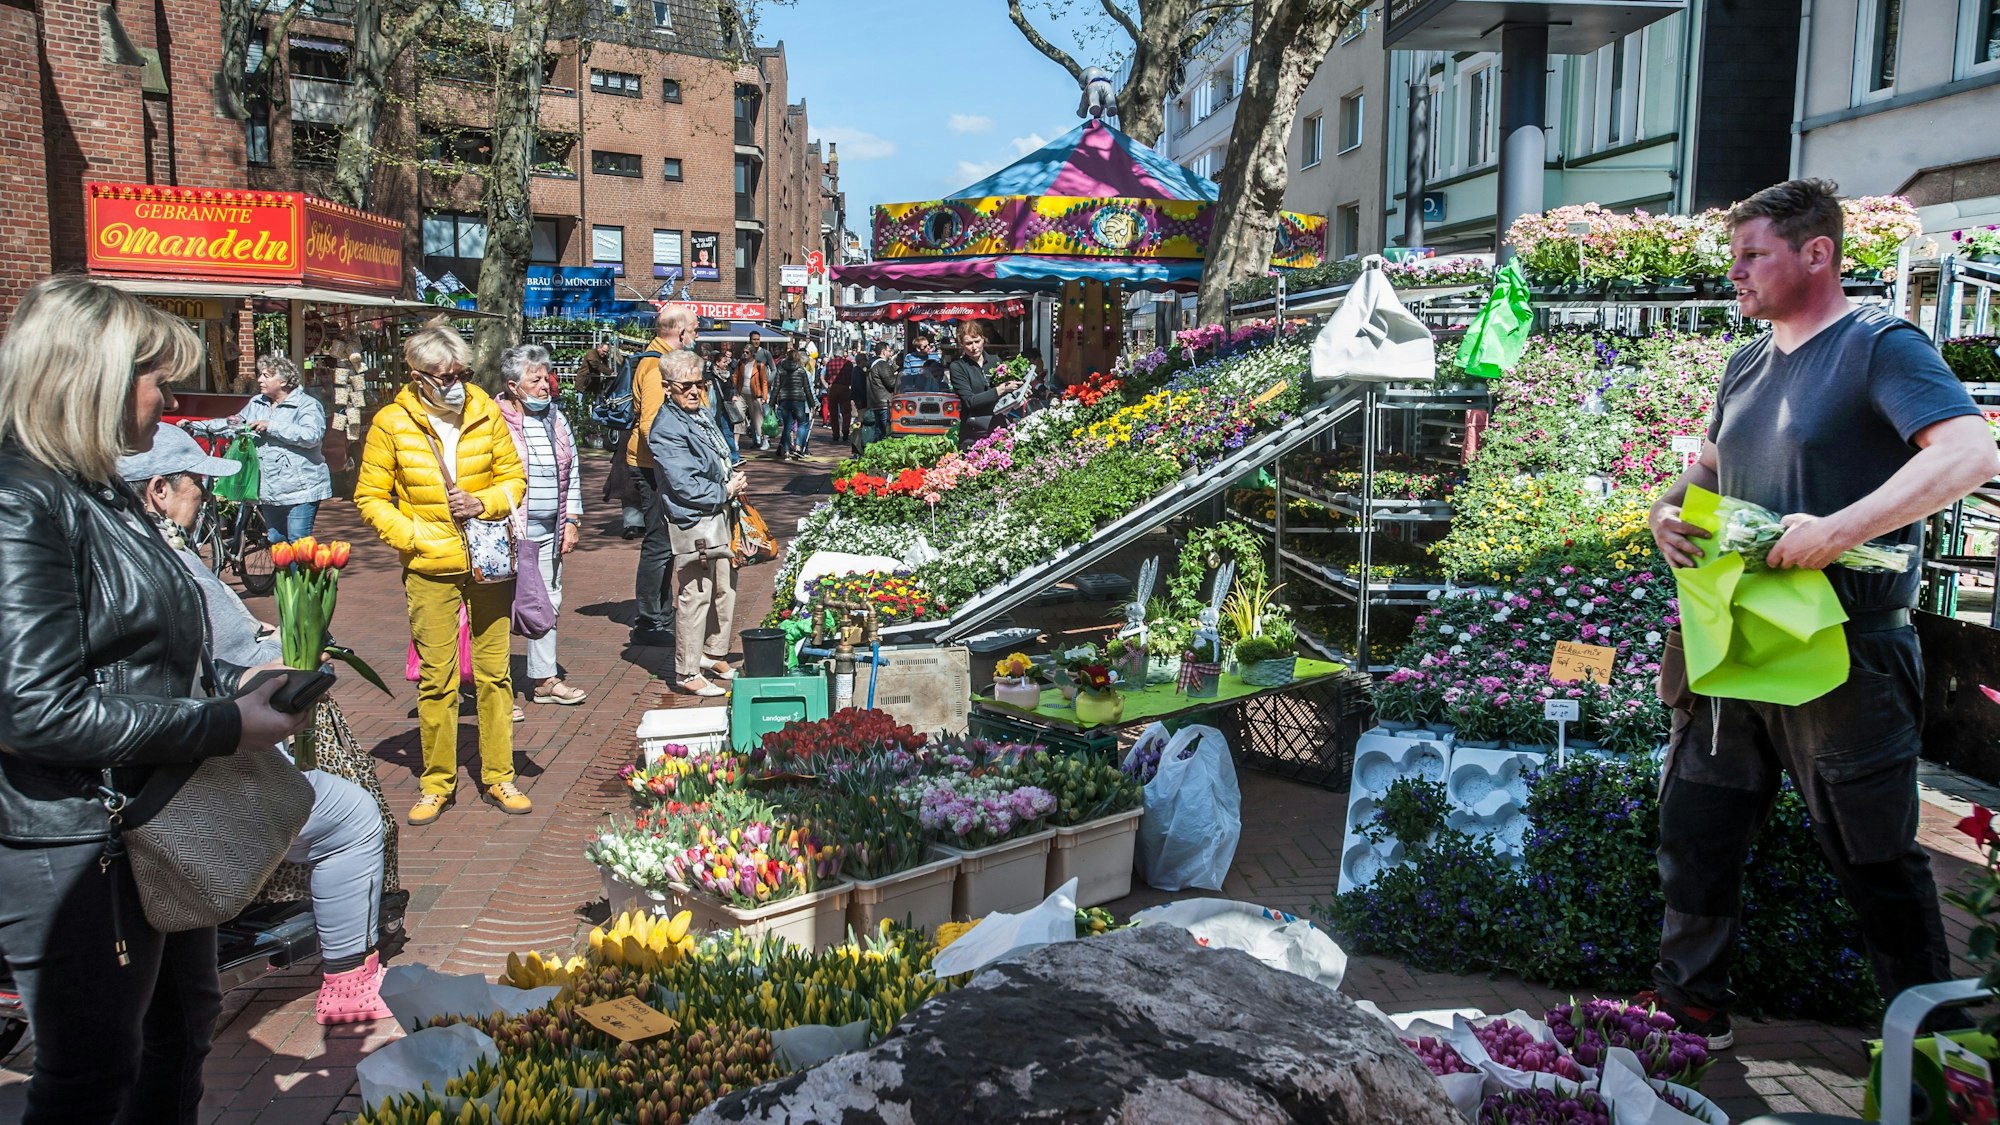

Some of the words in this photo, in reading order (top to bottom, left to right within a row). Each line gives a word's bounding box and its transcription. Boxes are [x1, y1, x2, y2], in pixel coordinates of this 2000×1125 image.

[135, 203, 253, 223] GEBRANNTE
[100, 222, 289, 262] Mandeln
[306, 220, 337, 260] Süße
[339, 229, 400, 266] Spezialitäten
[565, 277, 612, 286] MÜNCHEN
[655, 303, 698, 316] DER
[700, 304, 733, 317] TREFF
[1573, 662, 1608, 679] 30€
[762, 715, 791, 723] Landgard
